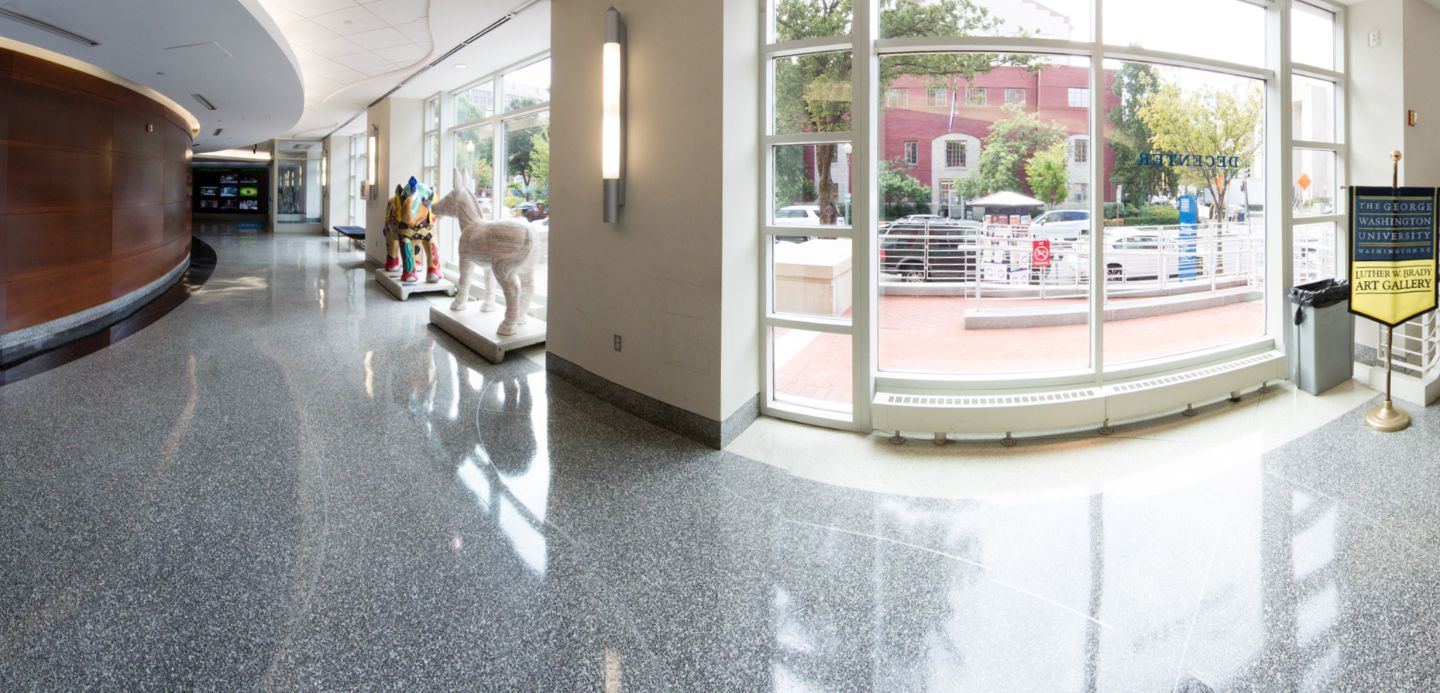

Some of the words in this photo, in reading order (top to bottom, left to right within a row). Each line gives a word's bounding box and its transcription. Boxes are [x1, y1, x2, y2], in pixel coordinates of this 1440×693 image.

[1359, 202, 1380, 210] THE
[1383, 202, 1433, 212] GEORGE
[1359, 217, 1432, 226] WASHINGTON
[1358, 231, 1431, 241] UNIVERSITY
[1355, 270, 1390, 280] LUTHER
[1403, 268, 1433, 278] BRADY
[1355, 281, 1379, 291] ART
[1382, 279, 1432, 291] GALLERY
